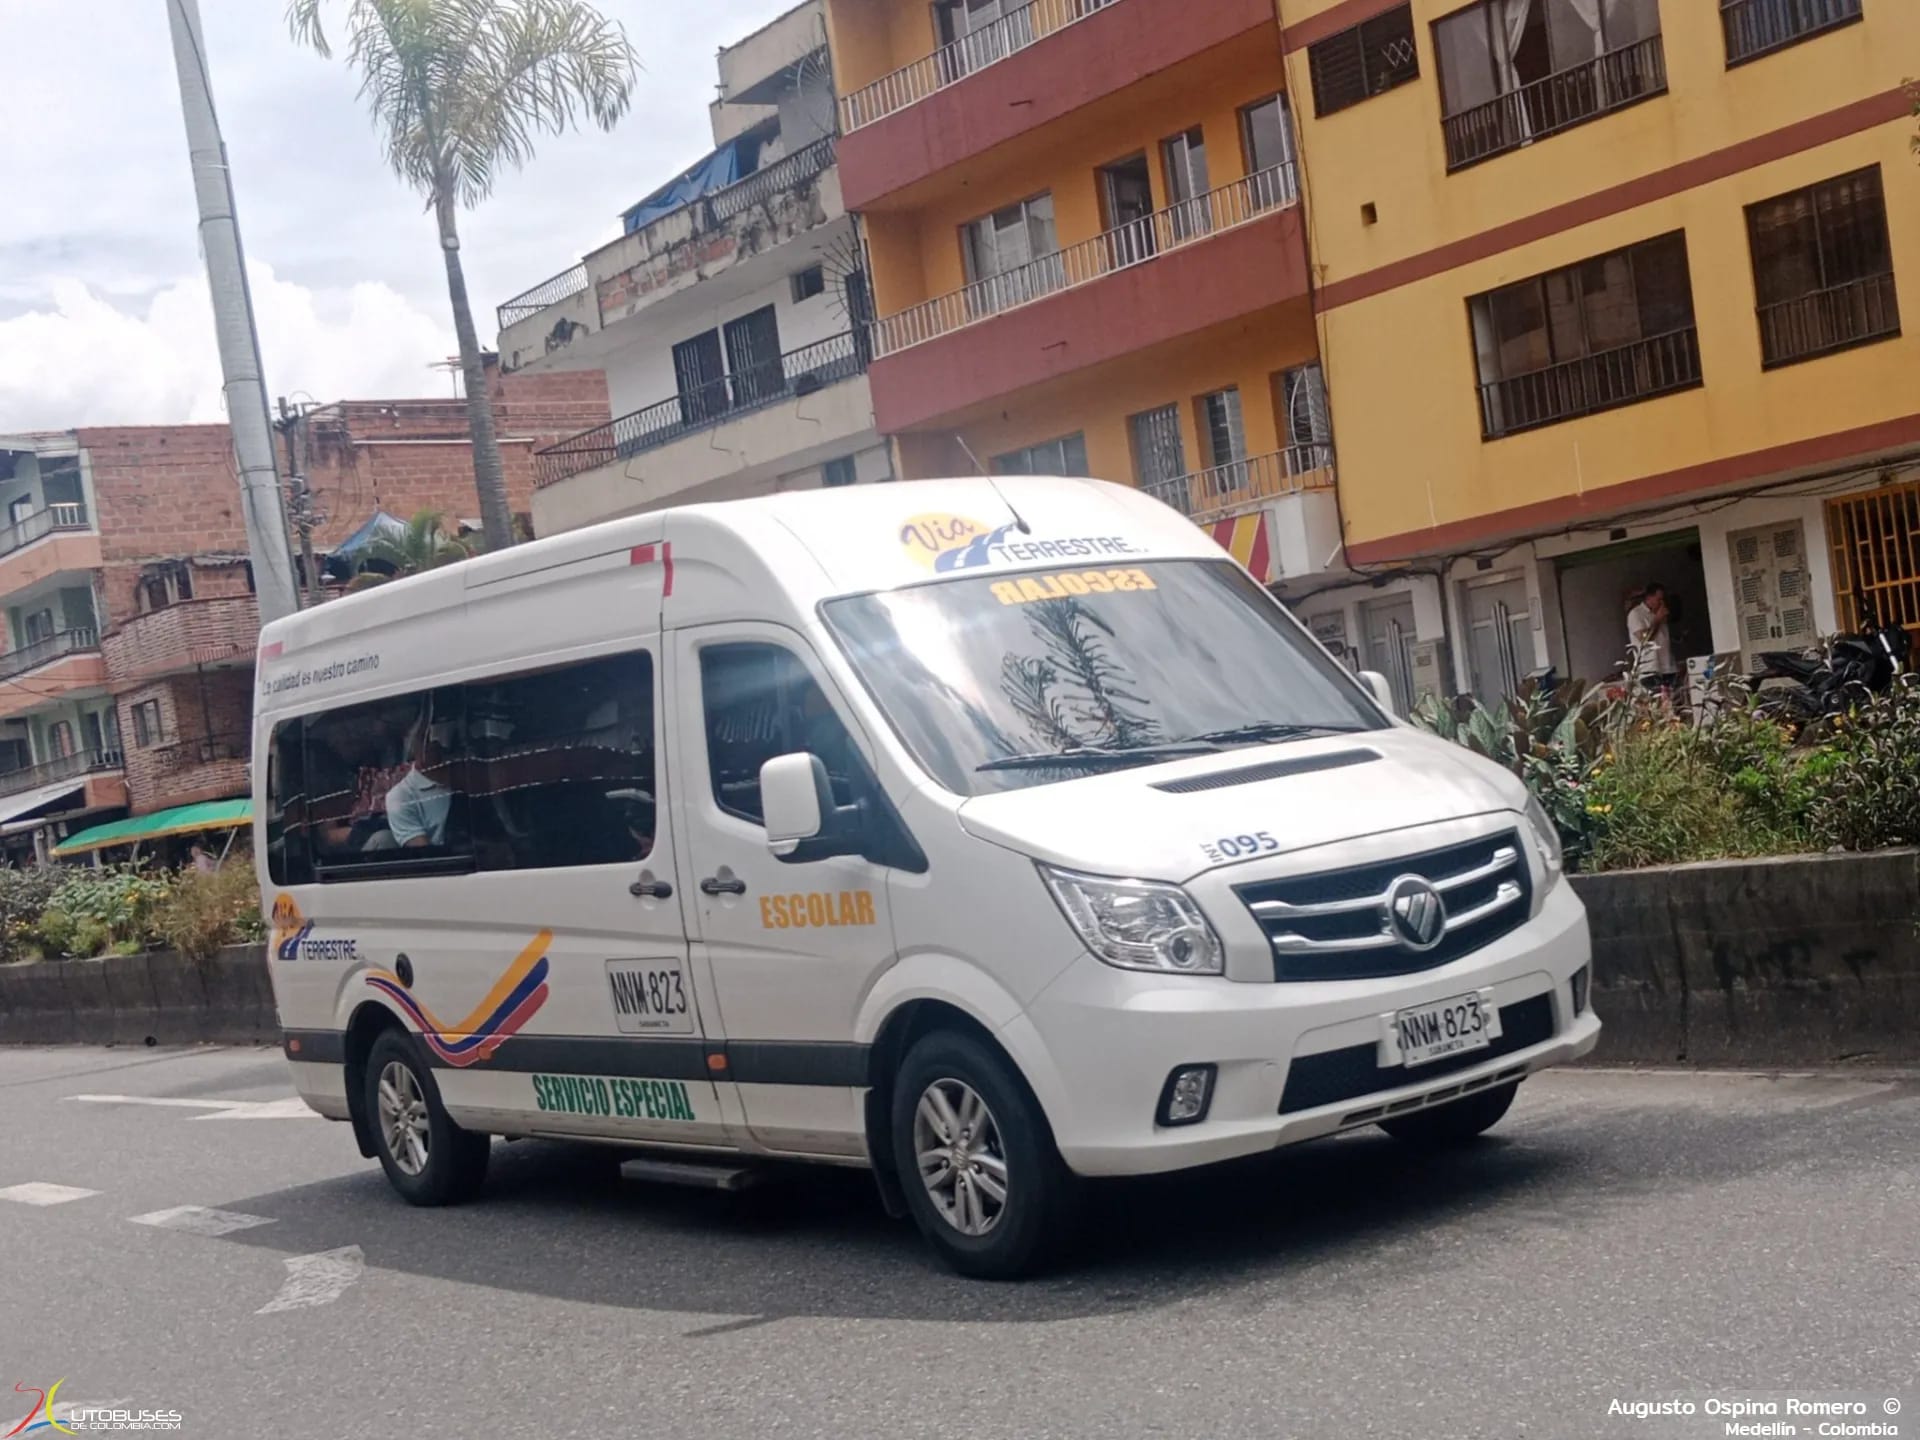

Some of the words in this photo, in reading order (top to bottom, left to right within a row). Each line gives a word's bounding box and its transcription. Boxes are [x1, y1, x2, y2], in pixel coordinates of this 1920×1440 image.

[991, 537, 1133, 563] TERRESTRE
[312, 661, 345, 682] nuestro
[346, 654, 380, 675] camino
[1217, 831, 1279, 857] 095
[760, 890, 876, 929] ESCOLAR
[301, 939, 358, 960] TERRESTRE
[532, 1074, 611, 1116] SERVICIO
[609, 1079, 696, 1121] ESPECIAL
